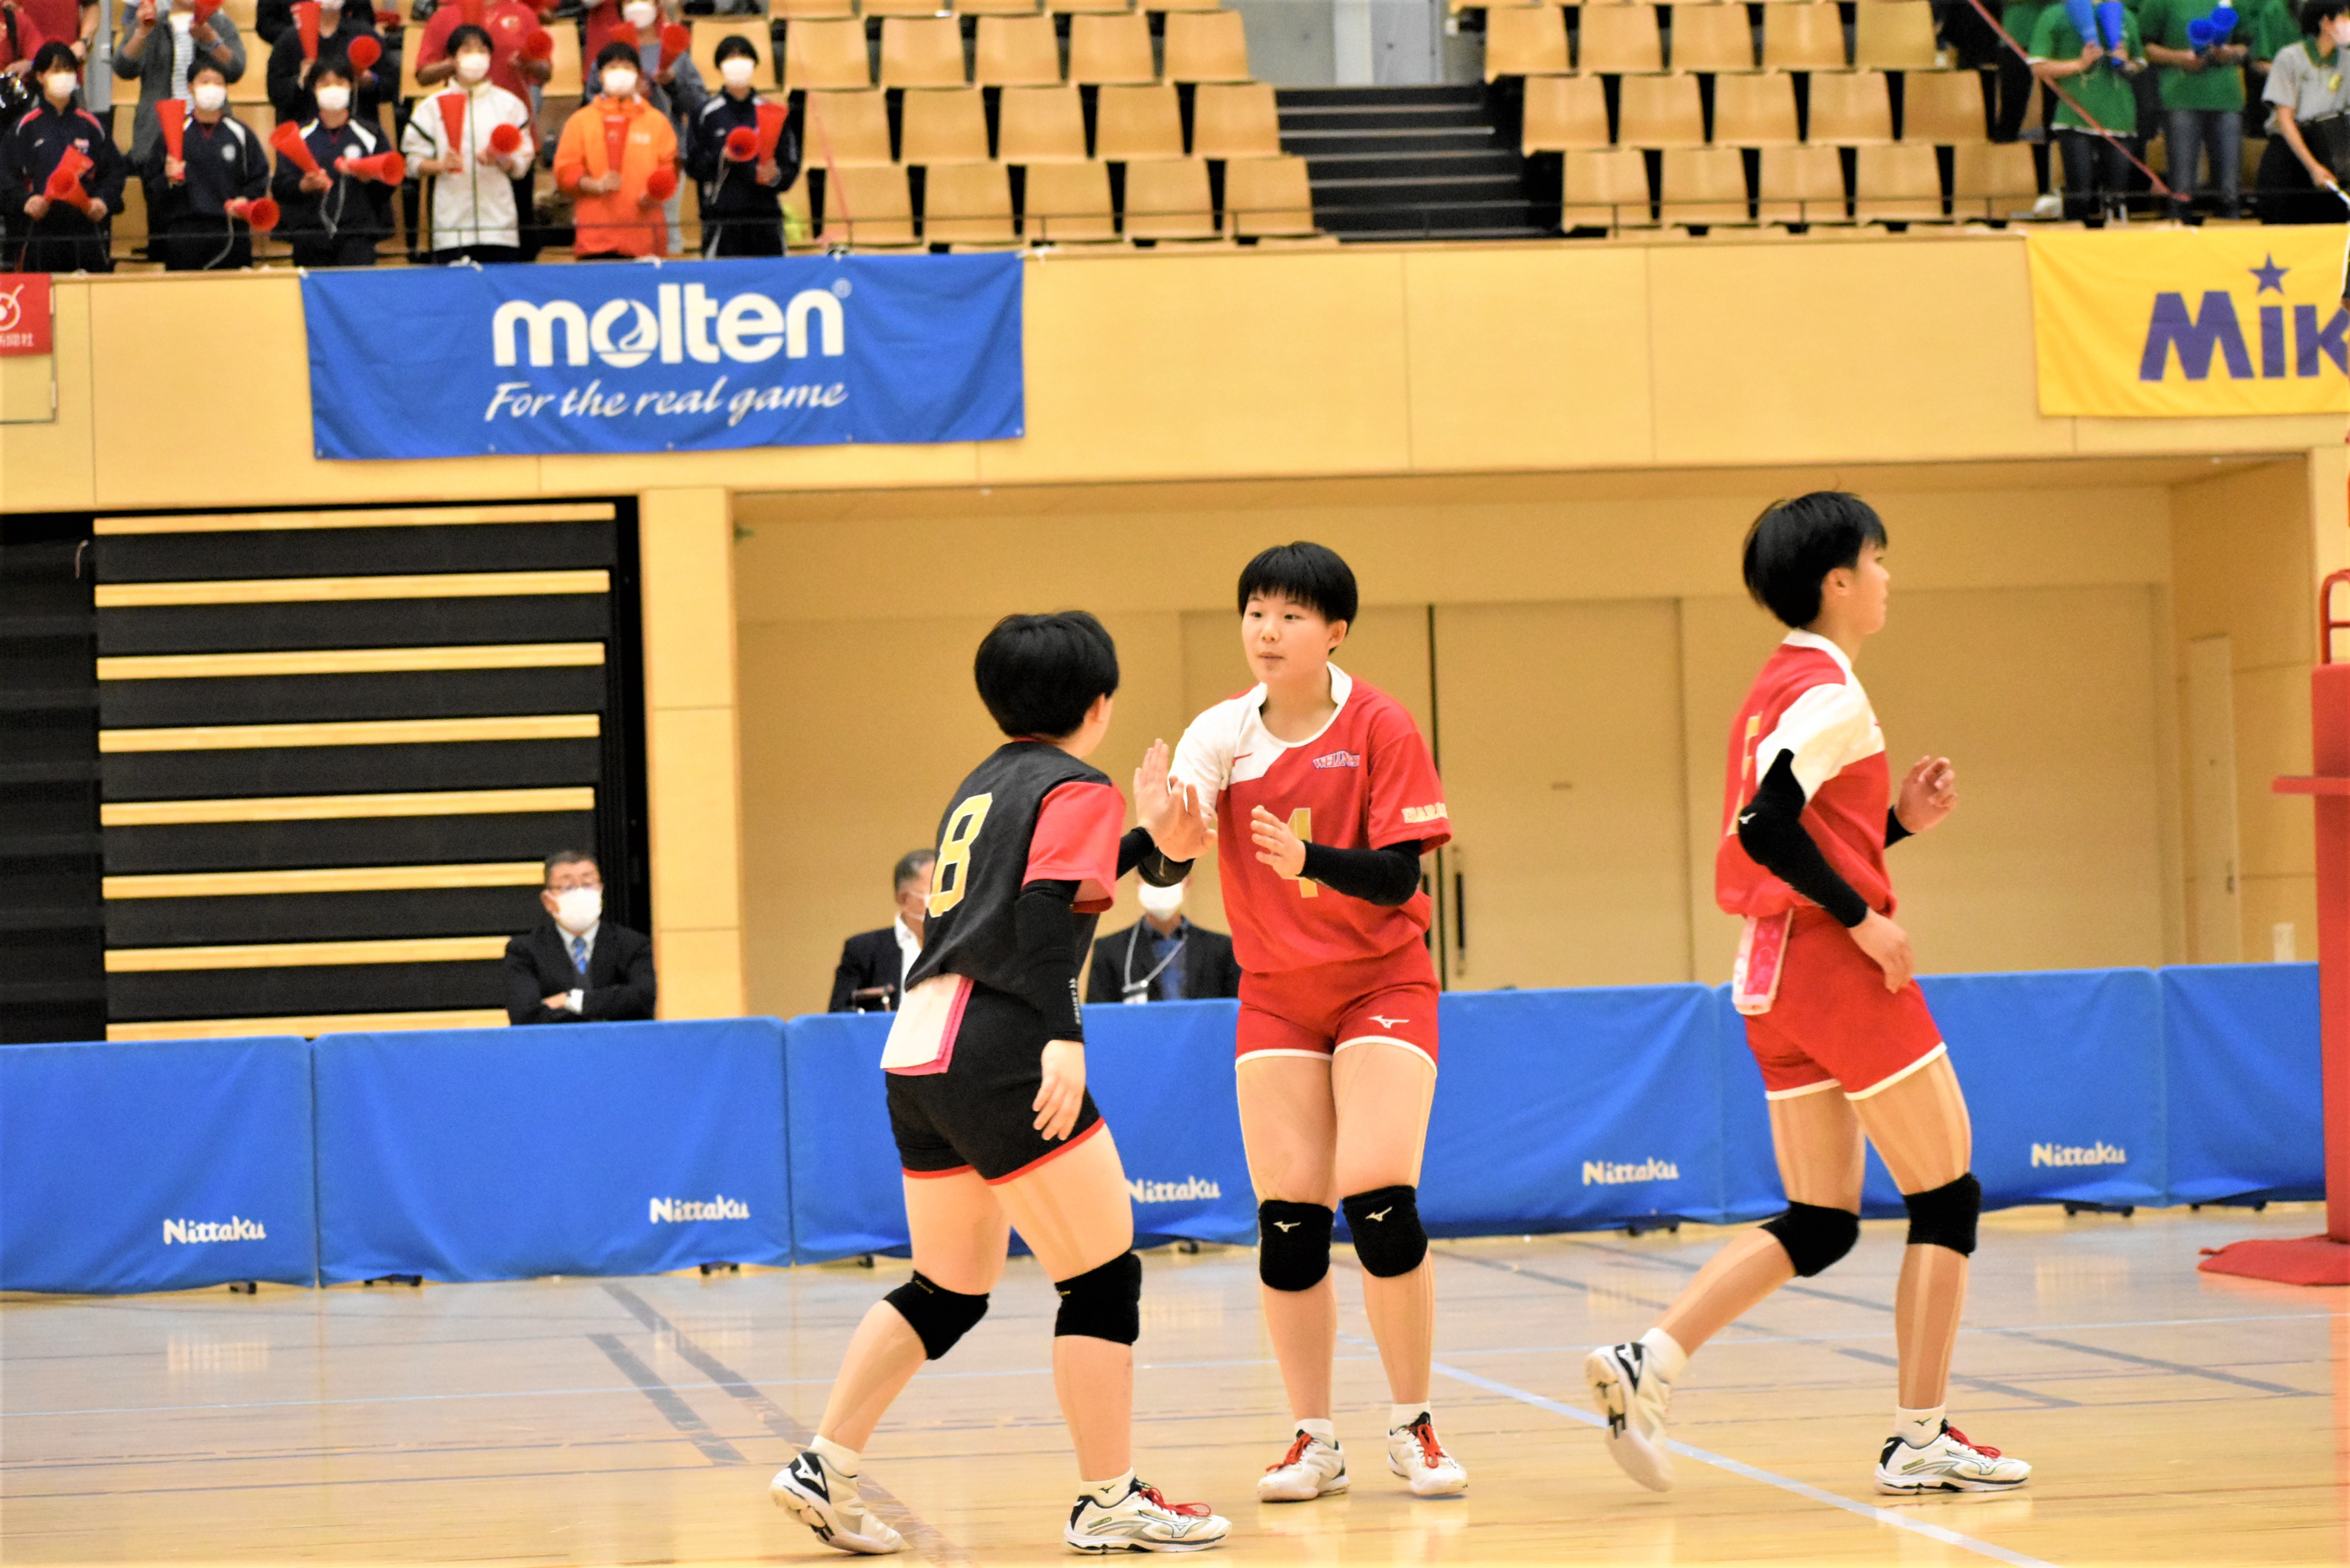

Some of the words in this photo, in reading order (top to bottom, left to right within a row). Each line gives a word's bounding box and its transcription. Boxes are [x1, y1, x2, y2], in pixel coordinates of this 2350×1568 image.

[493, 283, 844, 368] molten
[485, 381, 556, 422] For
[559, 378, 631, 417] the
[633, 375, 728, 416] real
[727, 382, 849, 426] game
[925, 792, 993, 918] 8
[2031, 1140, 2127, 1168] Nittaku
[1582, 1156, 1680, 1185] Nittaku
[1124, 1175, 1222, 1203] Nittaku
[650, 1194, 750, 1224] Nittaku
[163, 1215, 267, 1245] Nittaku
